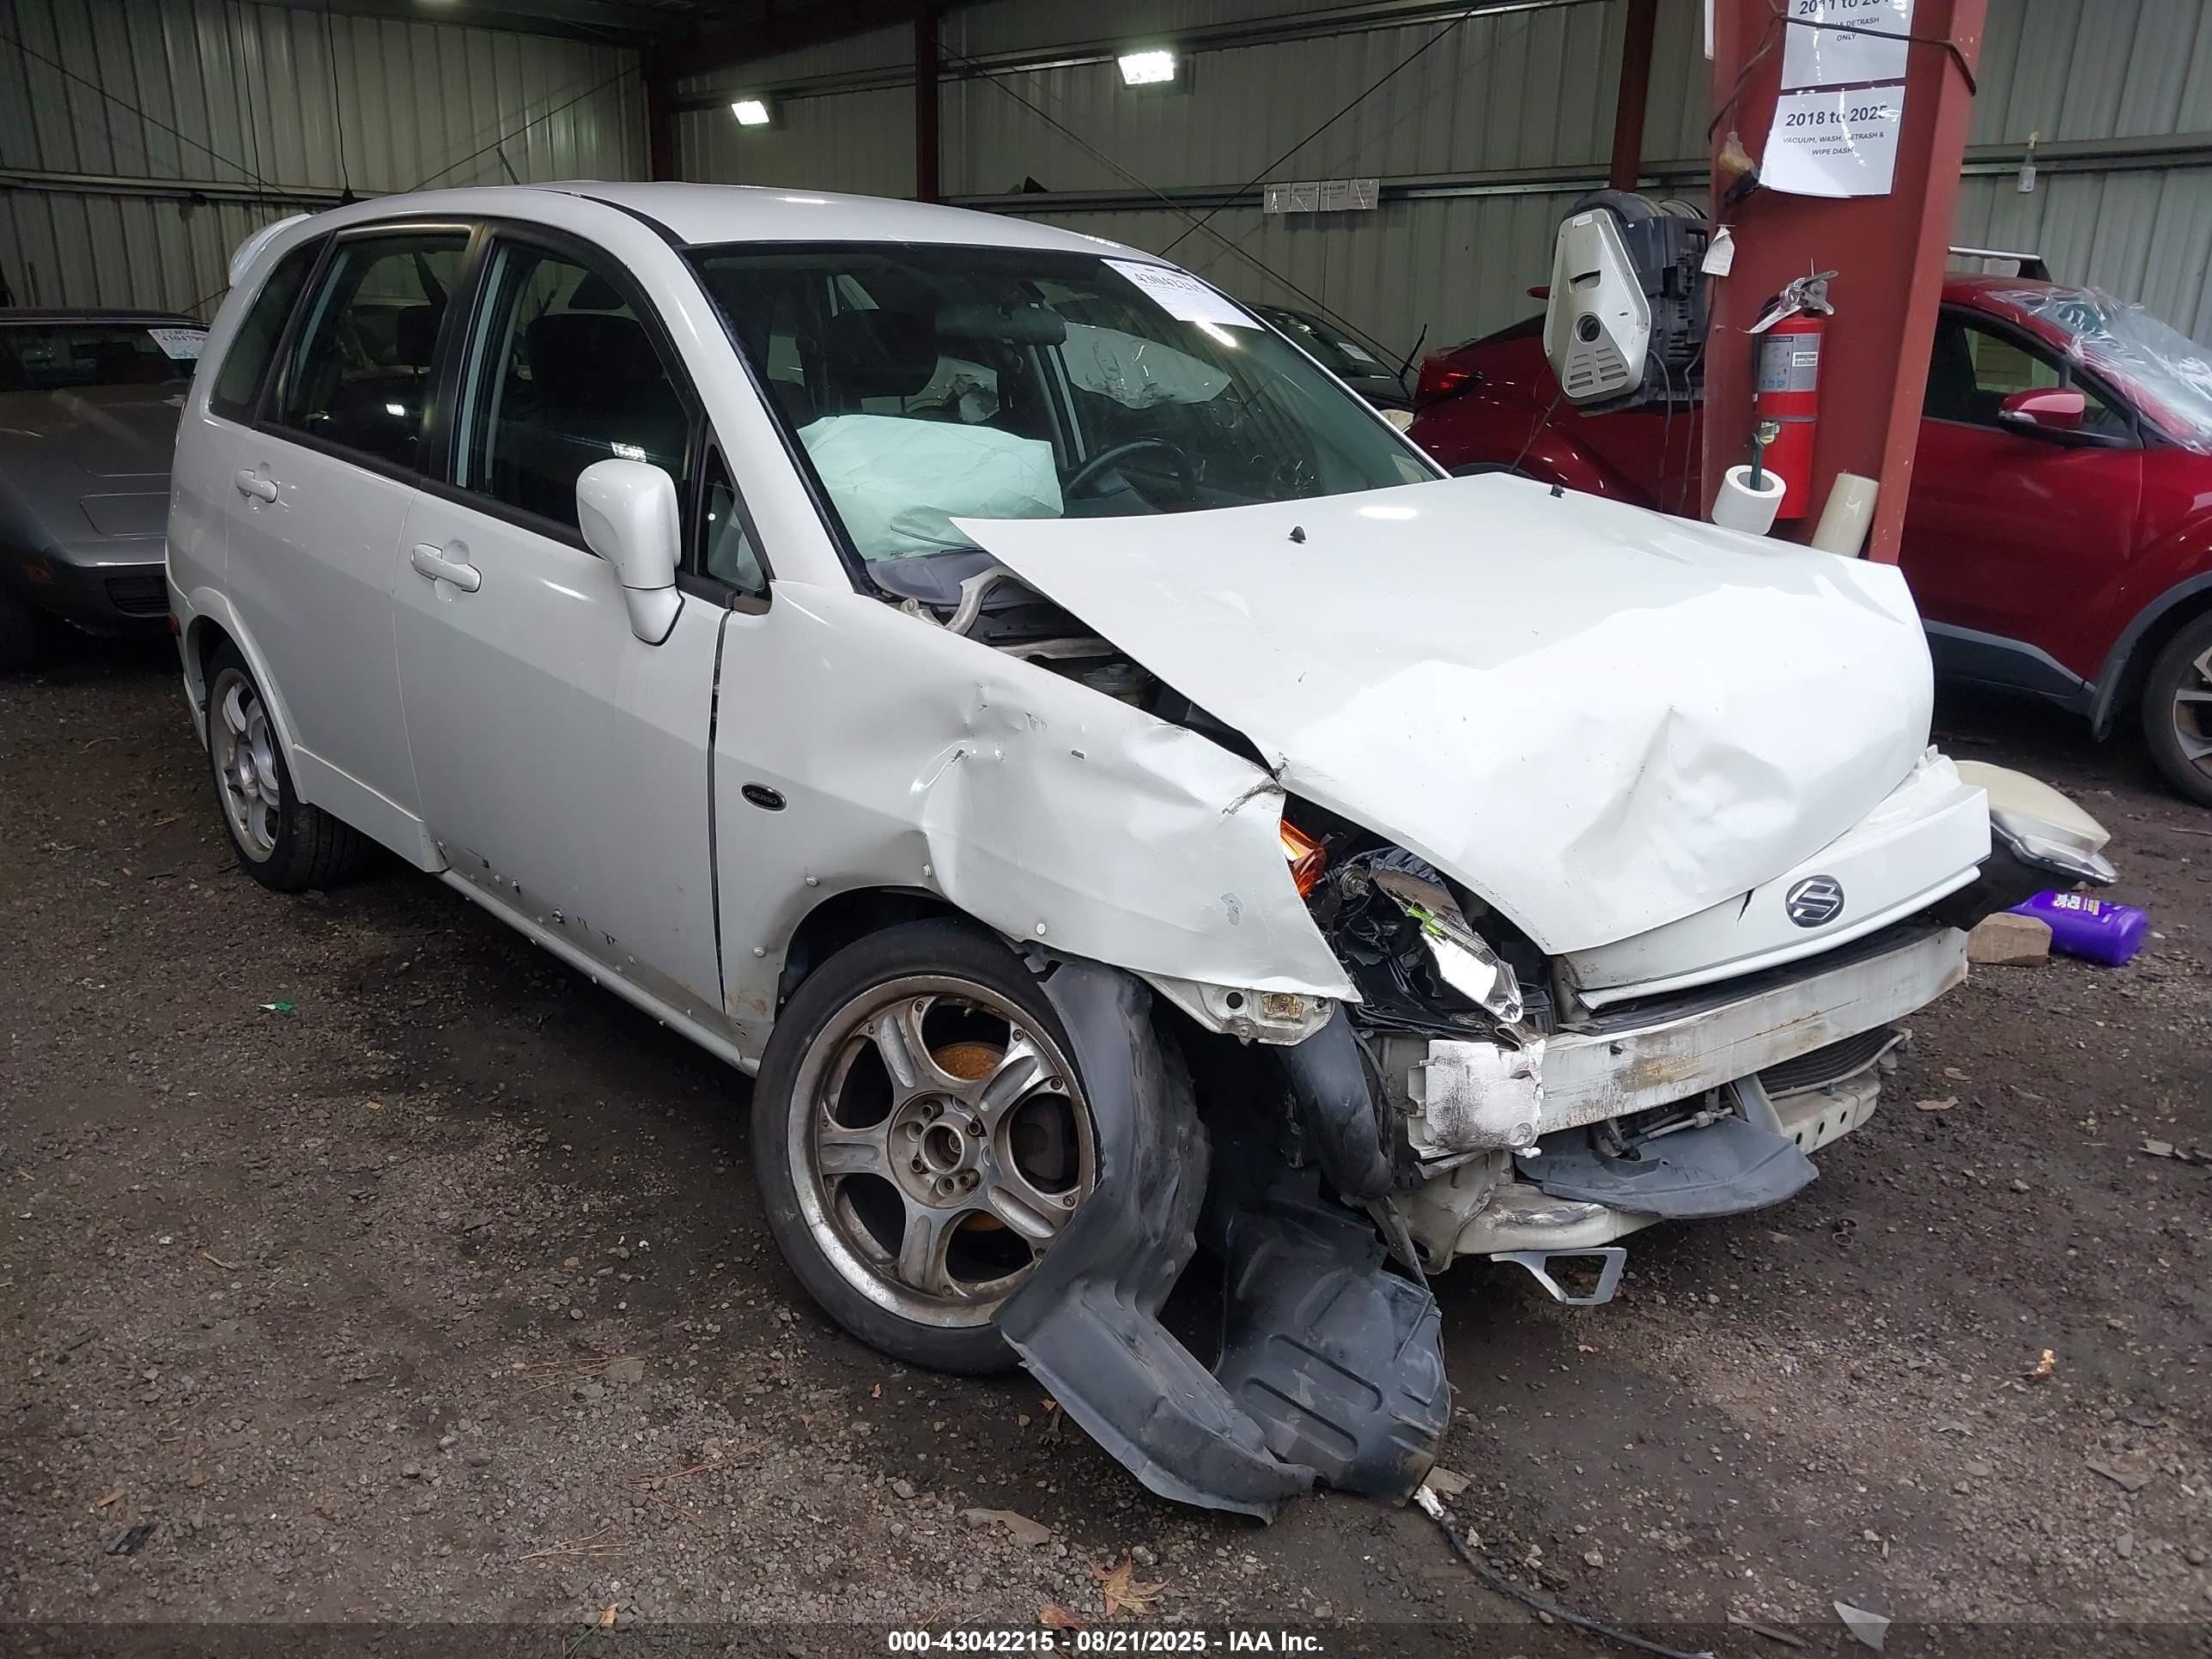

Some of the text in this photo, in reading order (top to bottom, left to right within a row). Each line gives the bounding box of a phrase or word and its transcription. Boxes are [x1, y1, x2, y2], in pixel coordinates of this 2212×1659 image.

[1846, 16, 1880, 28] DETRASH
[1836, 33, 1856, 41] ONLY
[1785, 105, 1887, 126] 2018 to 2025
[1819, 135, 1844, 143] WASH,
[1844, 131, 1878, 142] ETRASH
